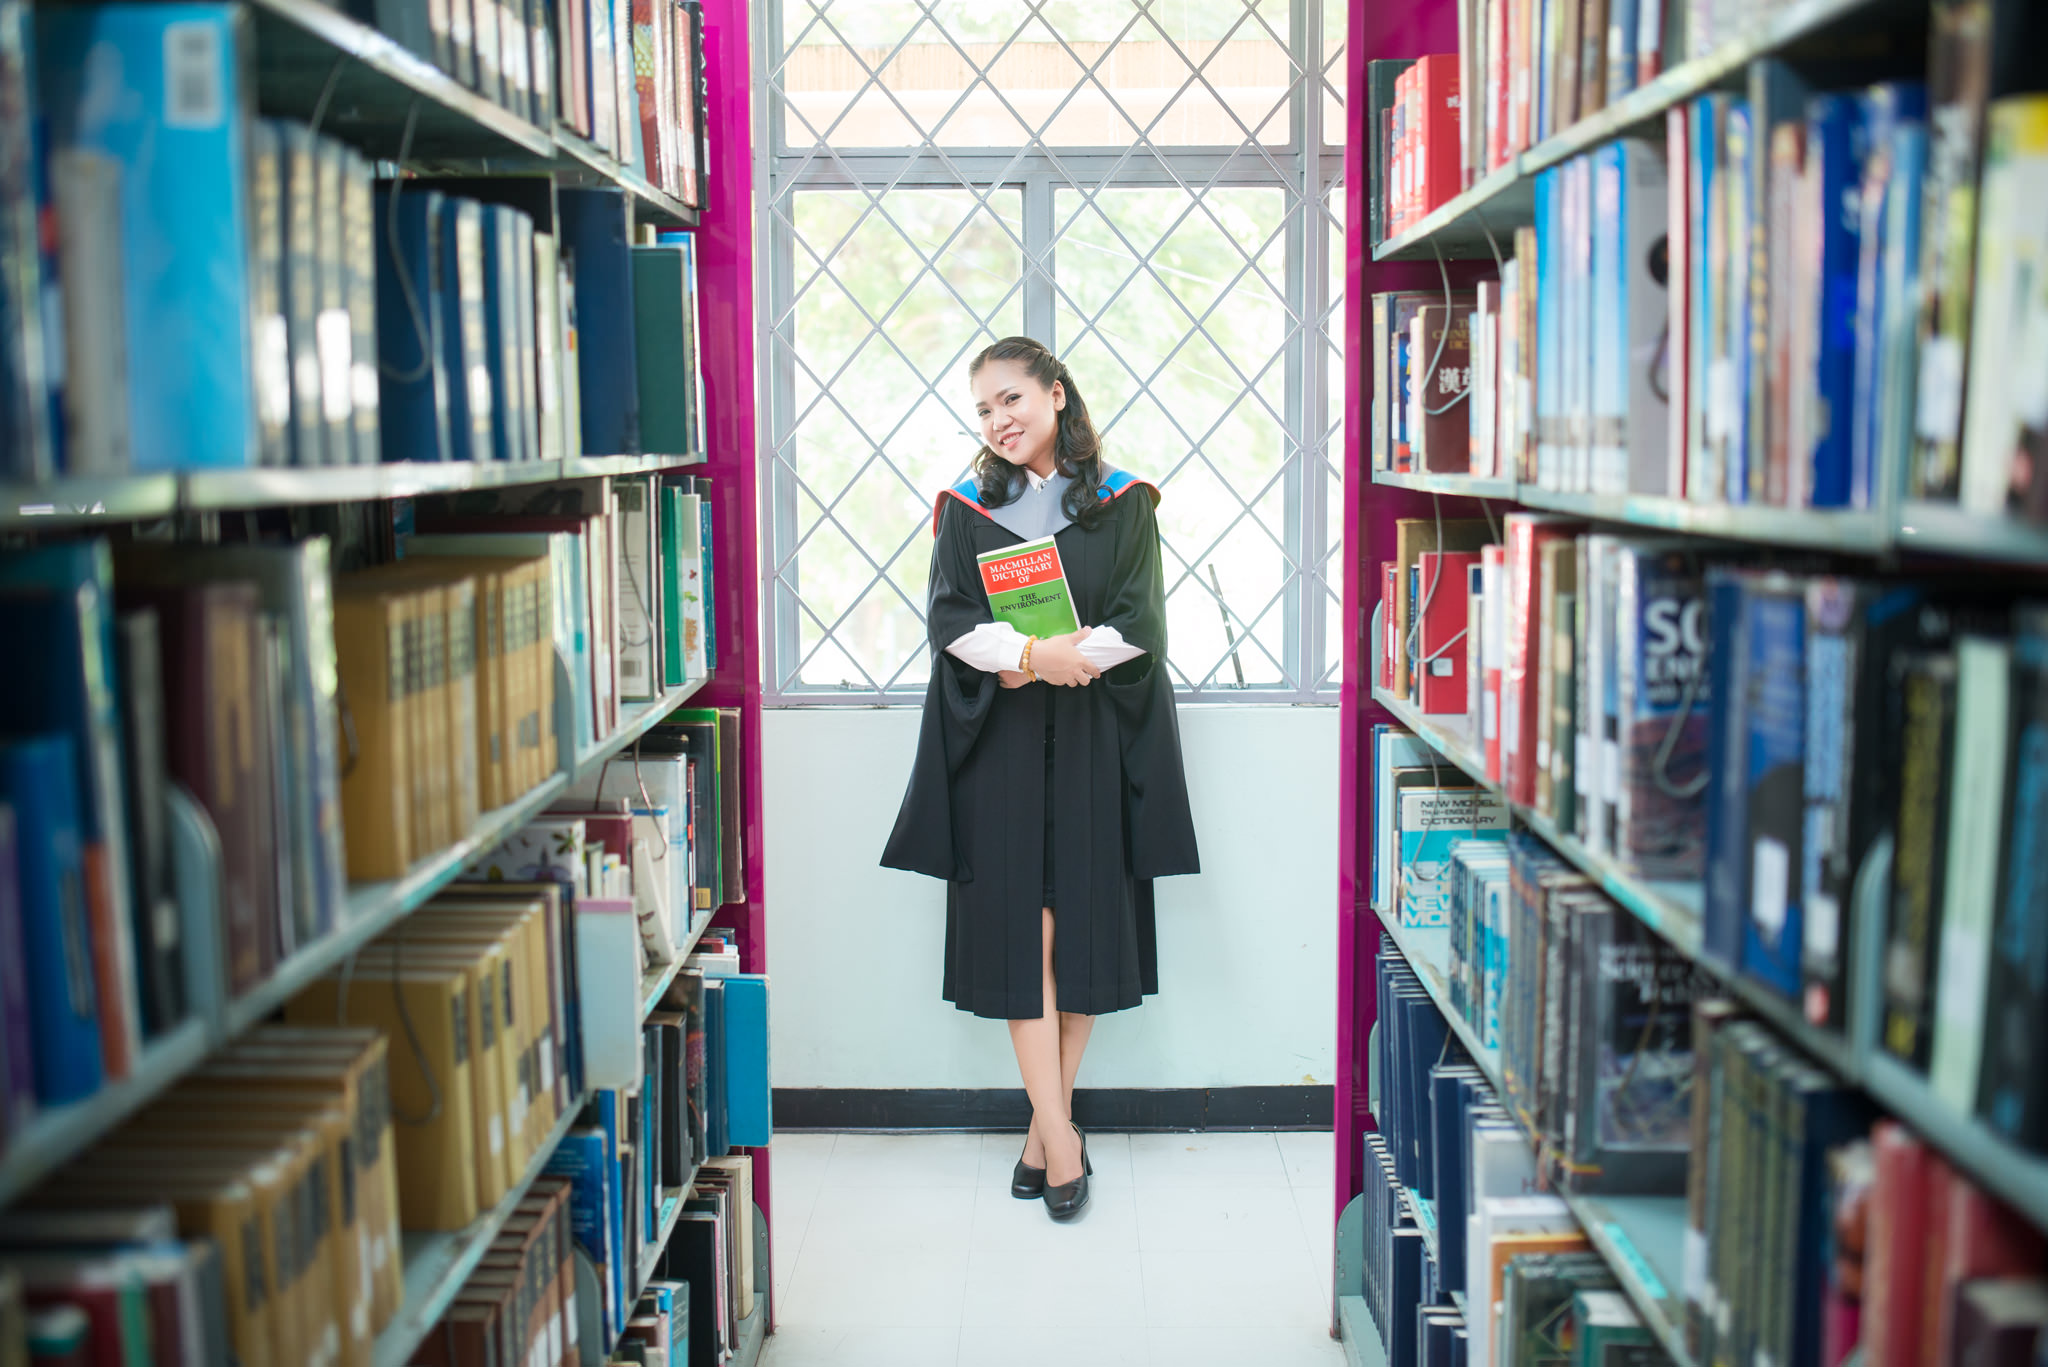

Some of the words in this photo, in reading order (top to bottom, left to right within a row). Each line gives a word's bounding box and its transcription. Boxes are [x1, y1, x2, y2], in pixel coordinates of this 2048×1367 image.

[989, 553, 1051, 574] MACMILLAN
[991, 561, 1052, 582] DICTIONARY
[1018, 575, 1031, 584] OF
[1000, 593, 1062, 612] ENVIRONMENT
[1019, 592, 1037, 602] THE
[1420, 816, 1497, 826] DICTIONARY
